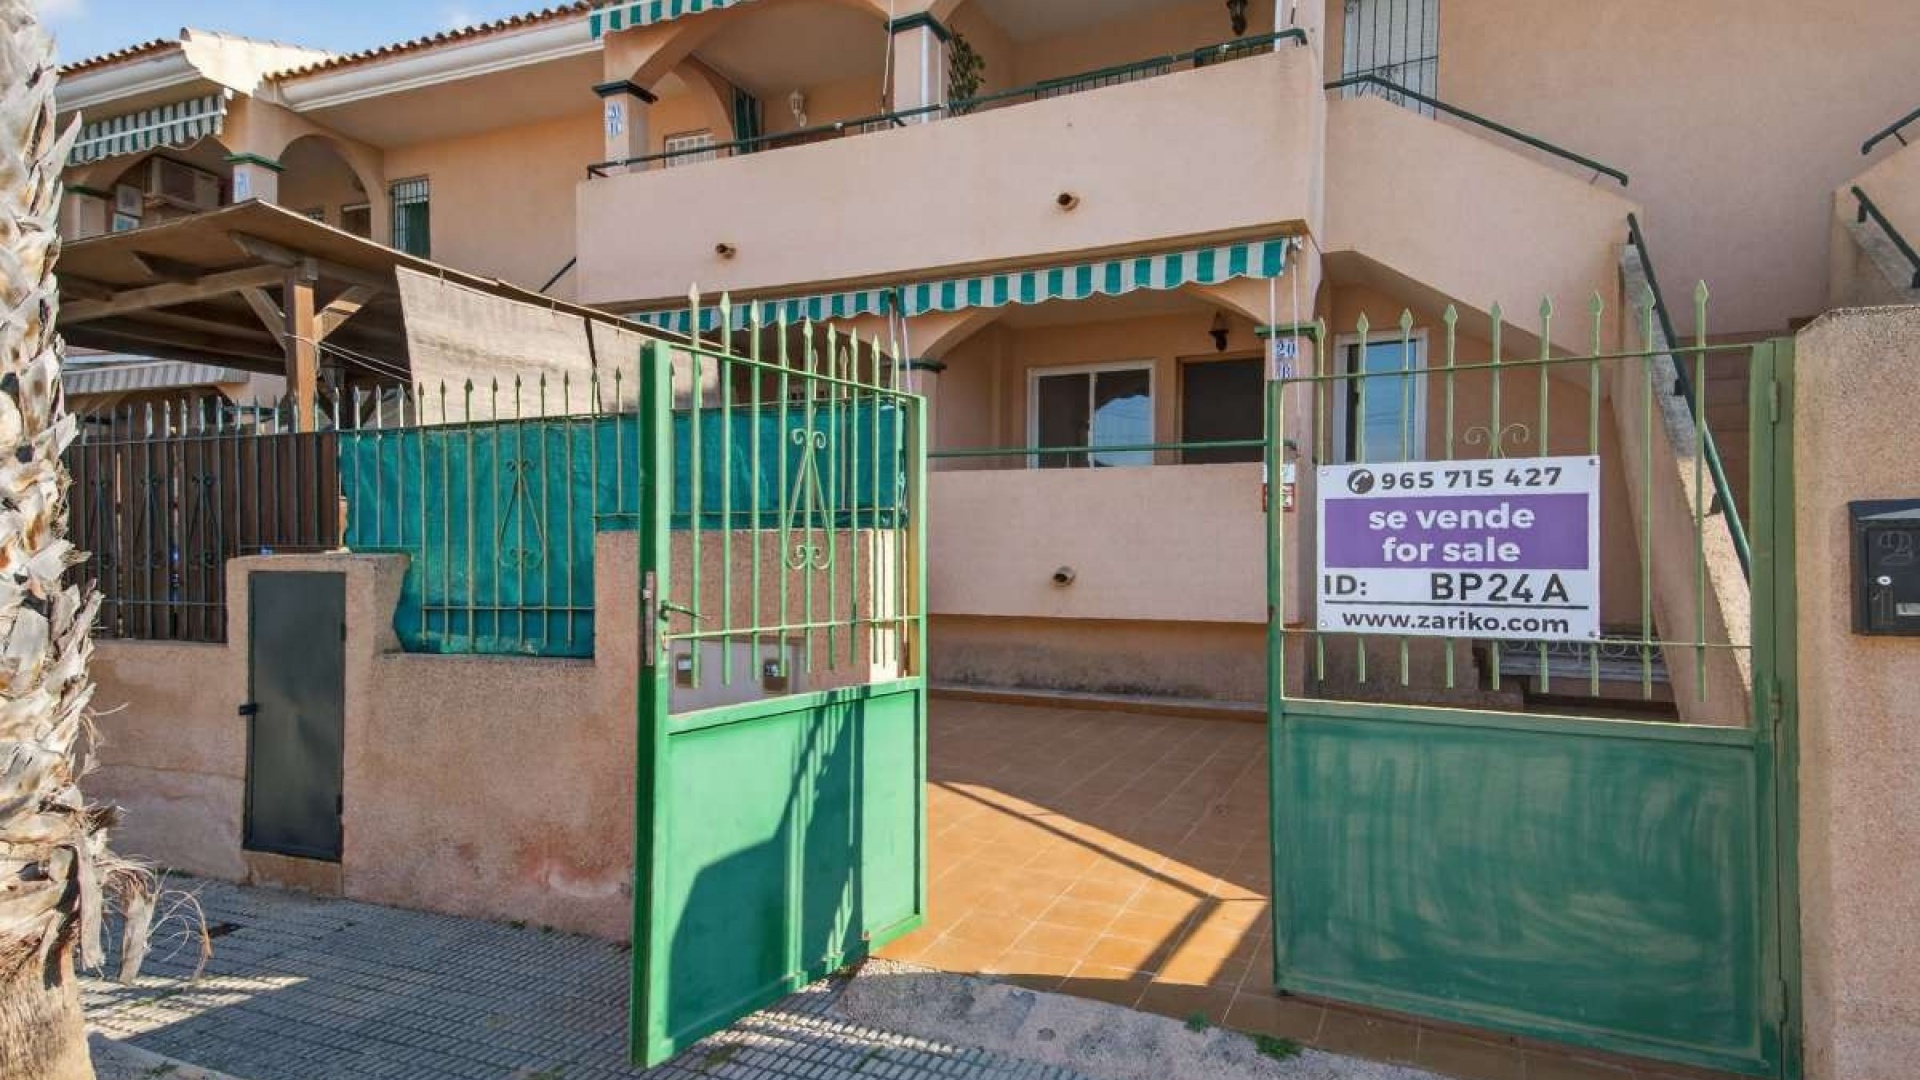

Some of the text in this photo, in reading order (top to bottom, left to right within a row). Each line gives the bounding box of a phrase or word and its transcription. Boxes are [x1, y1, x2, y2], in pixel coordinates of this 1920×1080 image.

[1276, 342, 1296, 358] 20
[1382, 467, 1562, 490] 965 715 427
[1369, 502, 1536, 530] se vende
[1382, 536, 1521, 562] for sale
[1324, 573, 1569, 603] ID: BP24A
[1342, 611, 1569, 633] www.zariko.com
